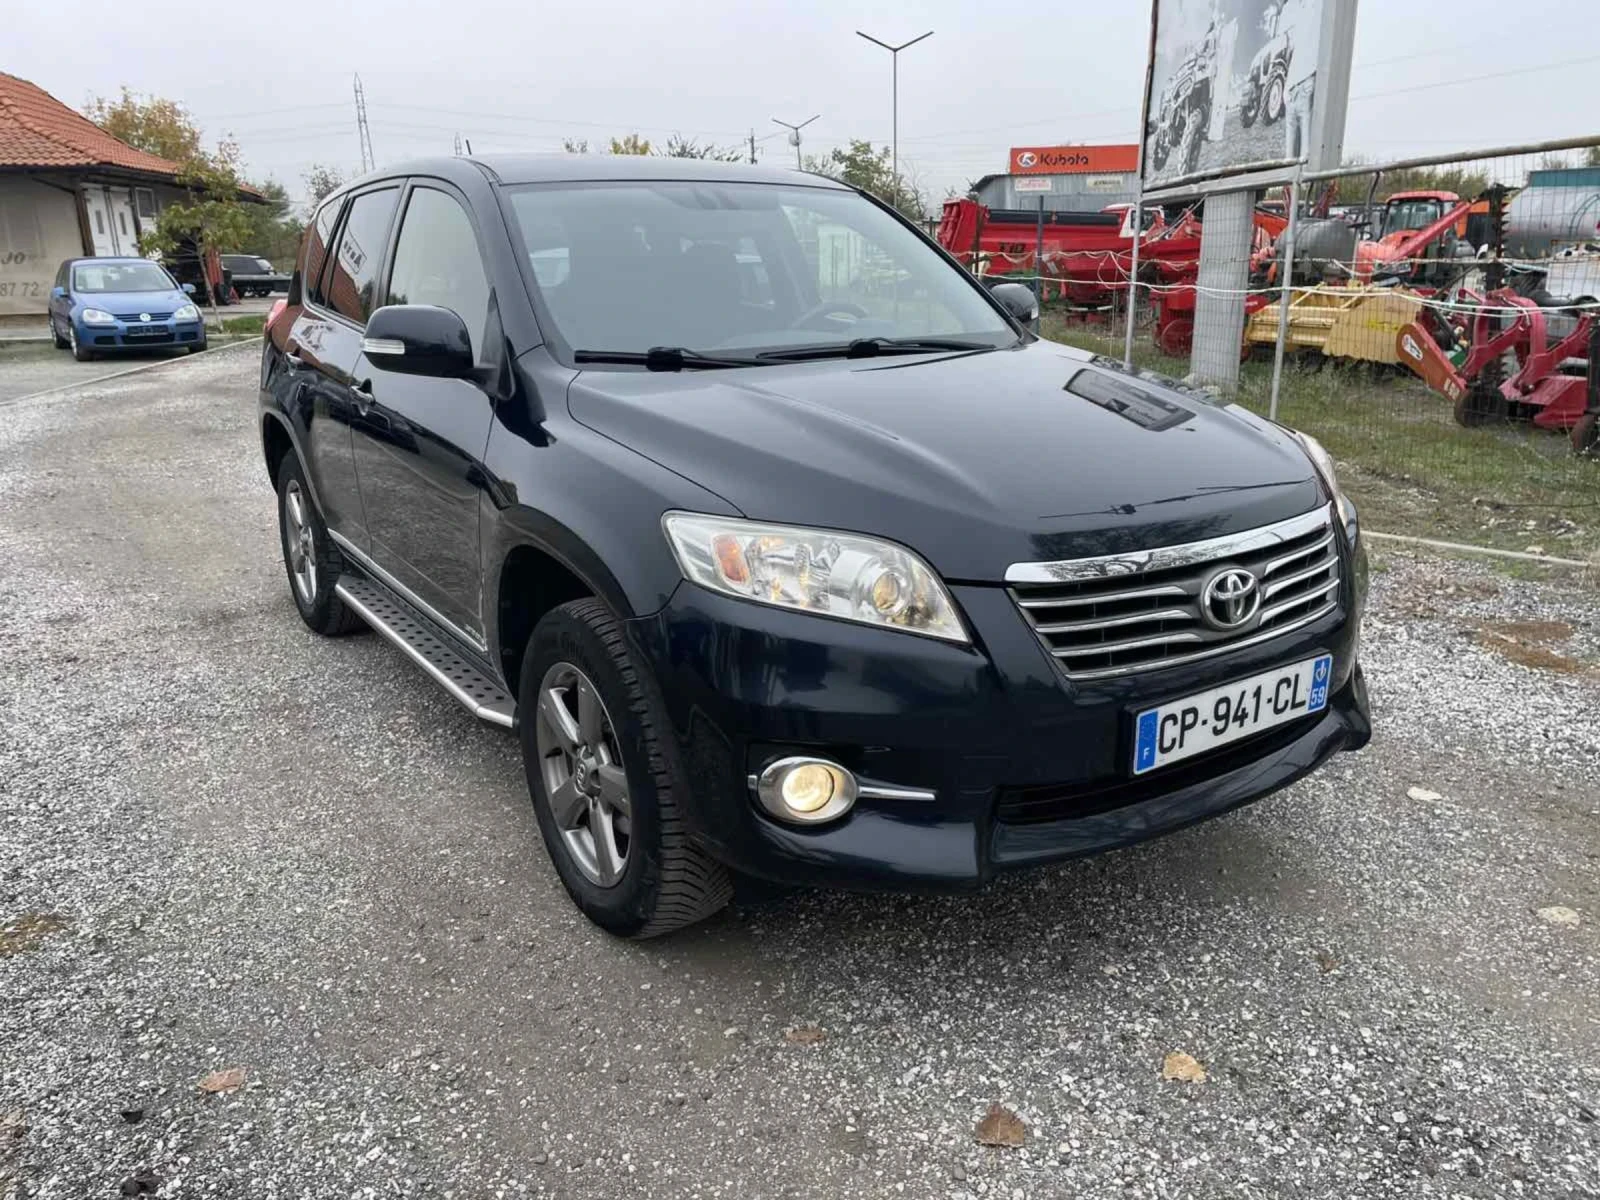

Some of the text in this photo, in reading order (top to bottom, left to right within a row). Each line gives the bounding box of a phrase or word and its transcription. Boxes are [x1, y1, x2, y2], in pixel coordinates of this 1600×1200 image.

[1040, 153, 1089, 165] Kubota
[22, 282, 40, 297] 72
[1310, 687, 1325, 706] 59
[1158, 673, 1306, 754] CP-941-CL
[1142, 748, 1150, 760] F
